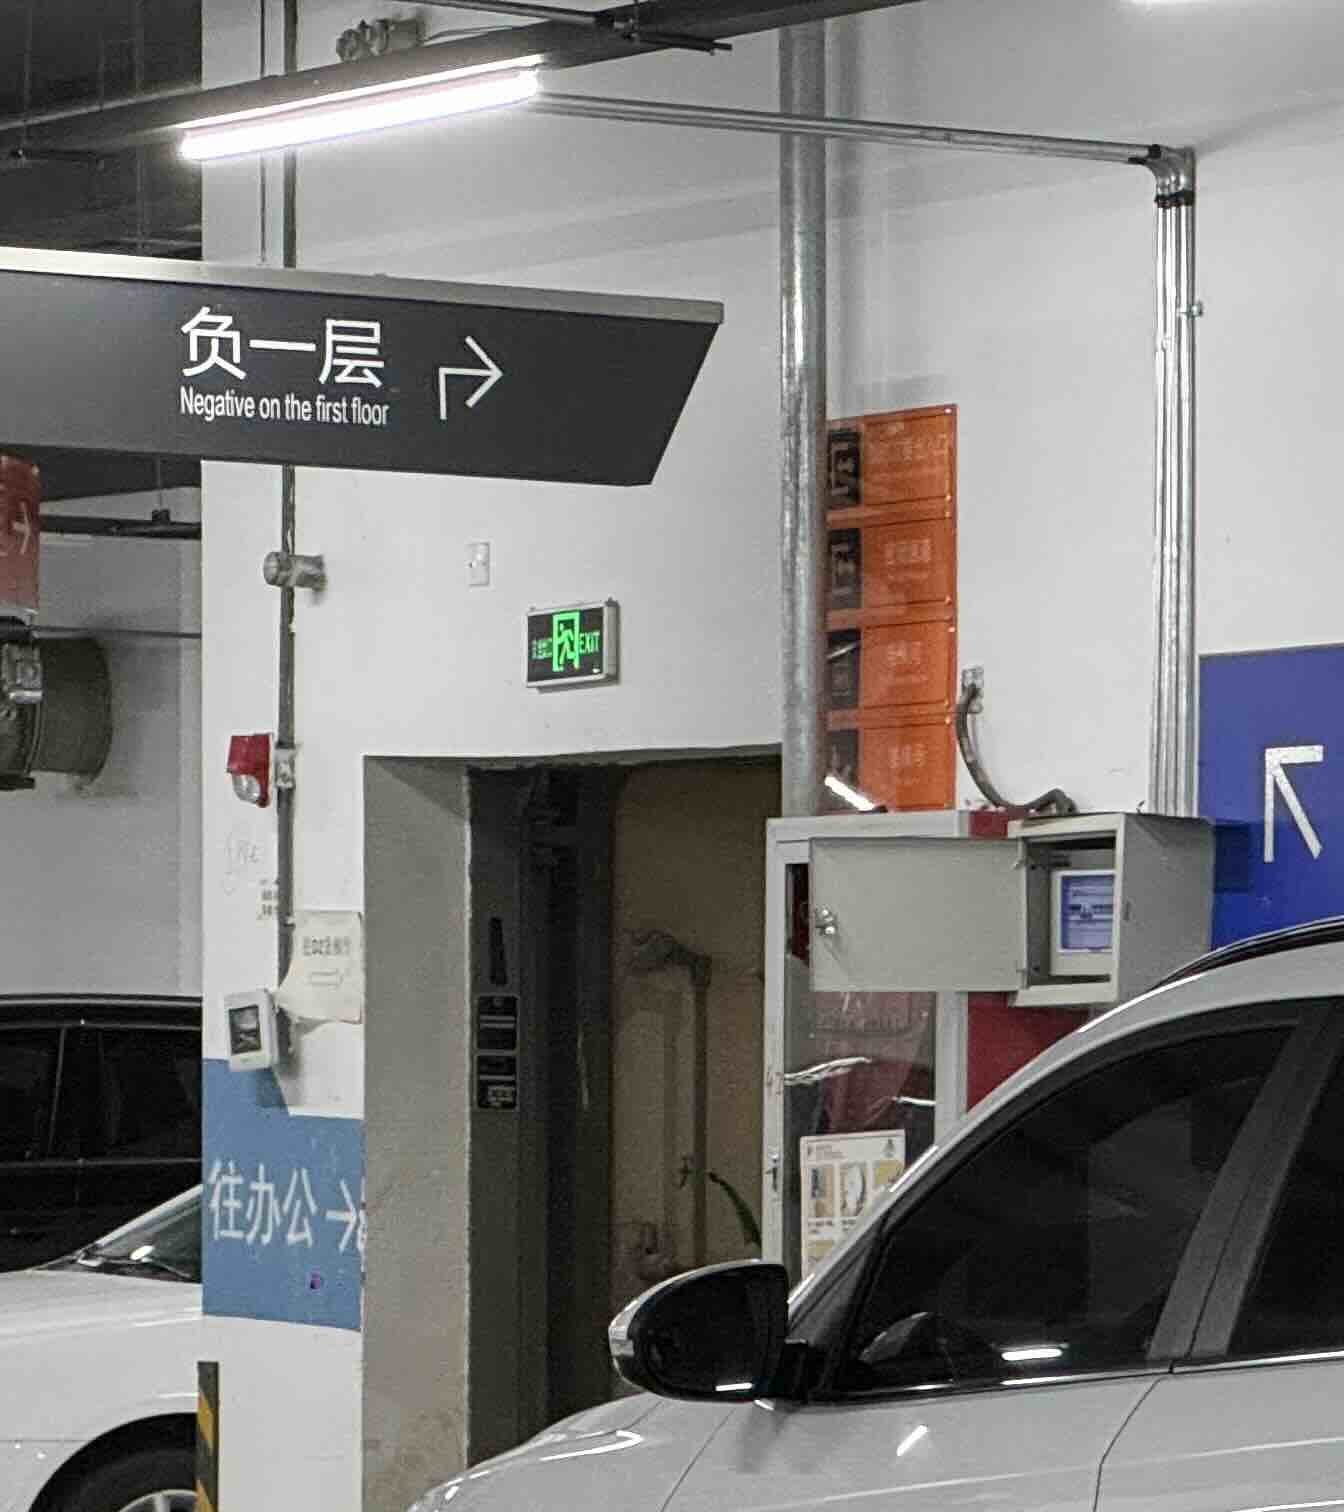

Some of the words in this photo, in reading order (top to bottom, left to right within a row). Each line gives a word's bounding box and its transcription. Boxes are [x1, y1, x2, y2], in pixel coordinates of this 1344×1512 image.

[180, 306, 385, 388] 负一层
[179, 385, 256, 422] Negative
[258, 396, 281, 419] on
[284, 392, 312, 421] the
[315, 394, 348, 423] first
[350, 396, 390, 425] floor
[579, 630, 600, 654] EXIT
